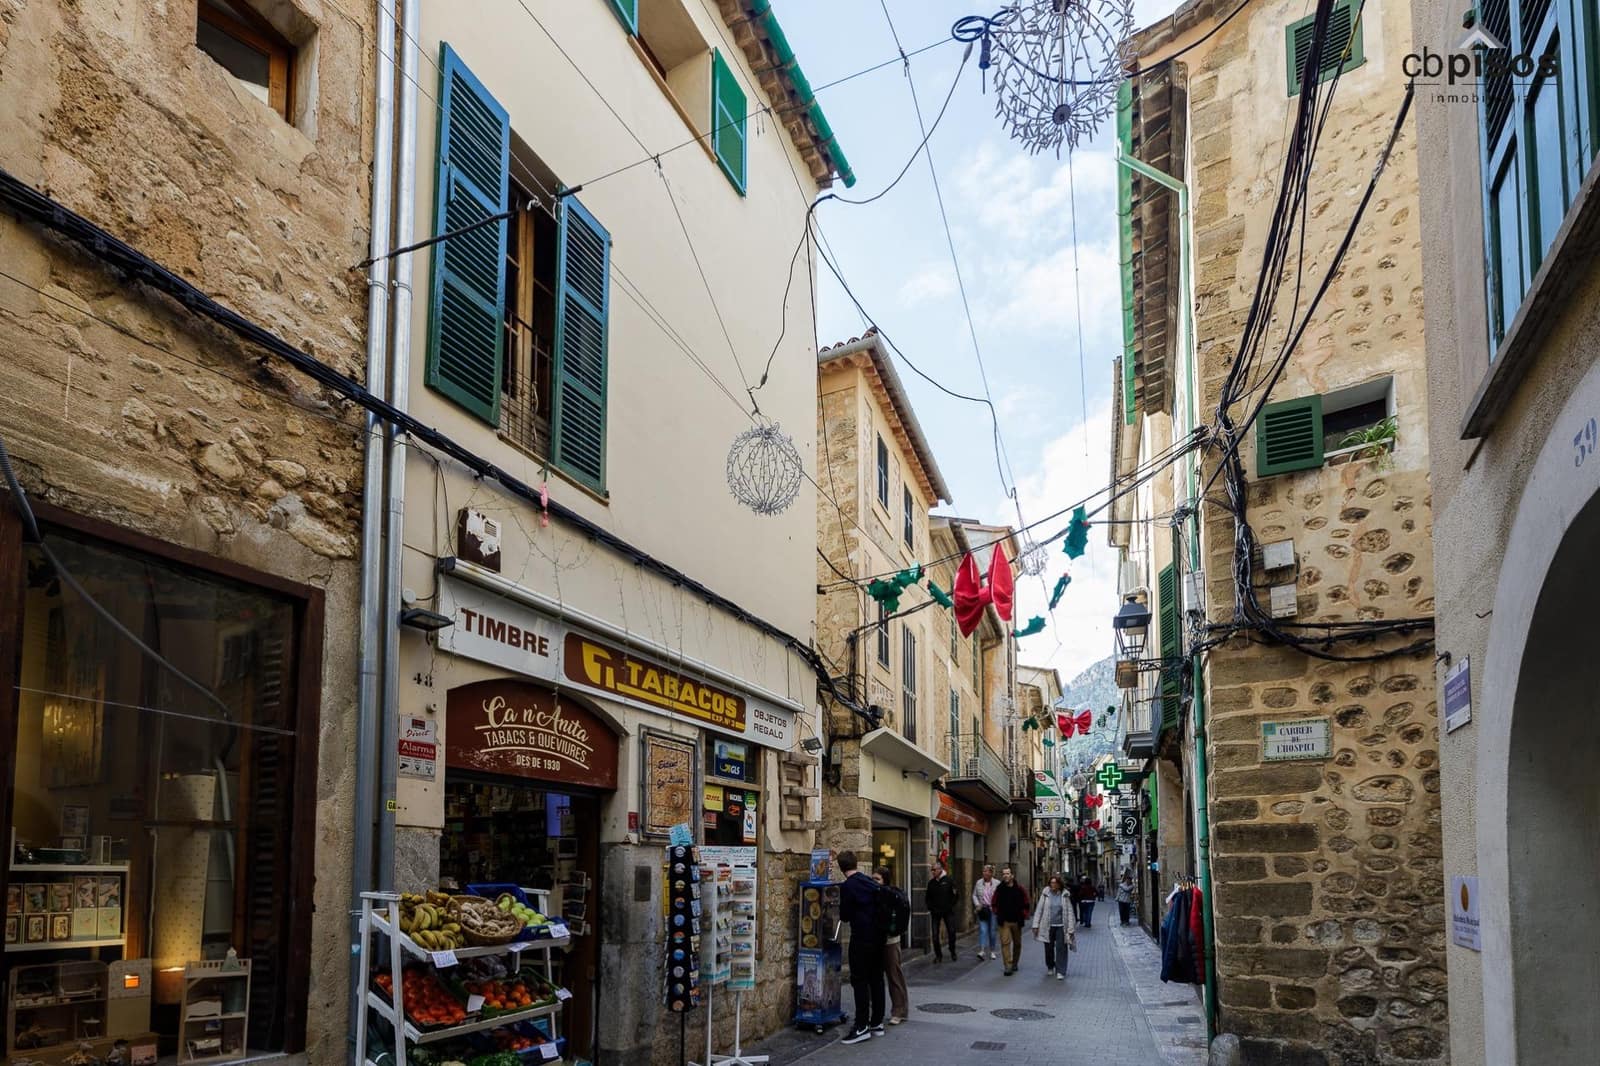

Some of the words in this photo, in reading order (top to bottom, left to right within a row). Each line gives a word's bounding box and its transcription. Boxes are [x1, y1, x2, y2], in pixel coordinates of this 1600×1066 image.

[461, 607, 549, 659] TIMBRE
[626, 661, 737, 718] TABACOS
[483, 696, 518, 728] Ca
[754, 709, 787, 728] OBJETOS
[754, 723, 783, 740] REGALO
[402, 742, 435, 754] Alarma
[484, 730, 526, 747] TABACS
[529, 731, 535, 745] &
[538, 733, 587, 762] QUEVIURES
[543, 759, 561, 771] 1930
[730, 766, 741, 775] GLS
